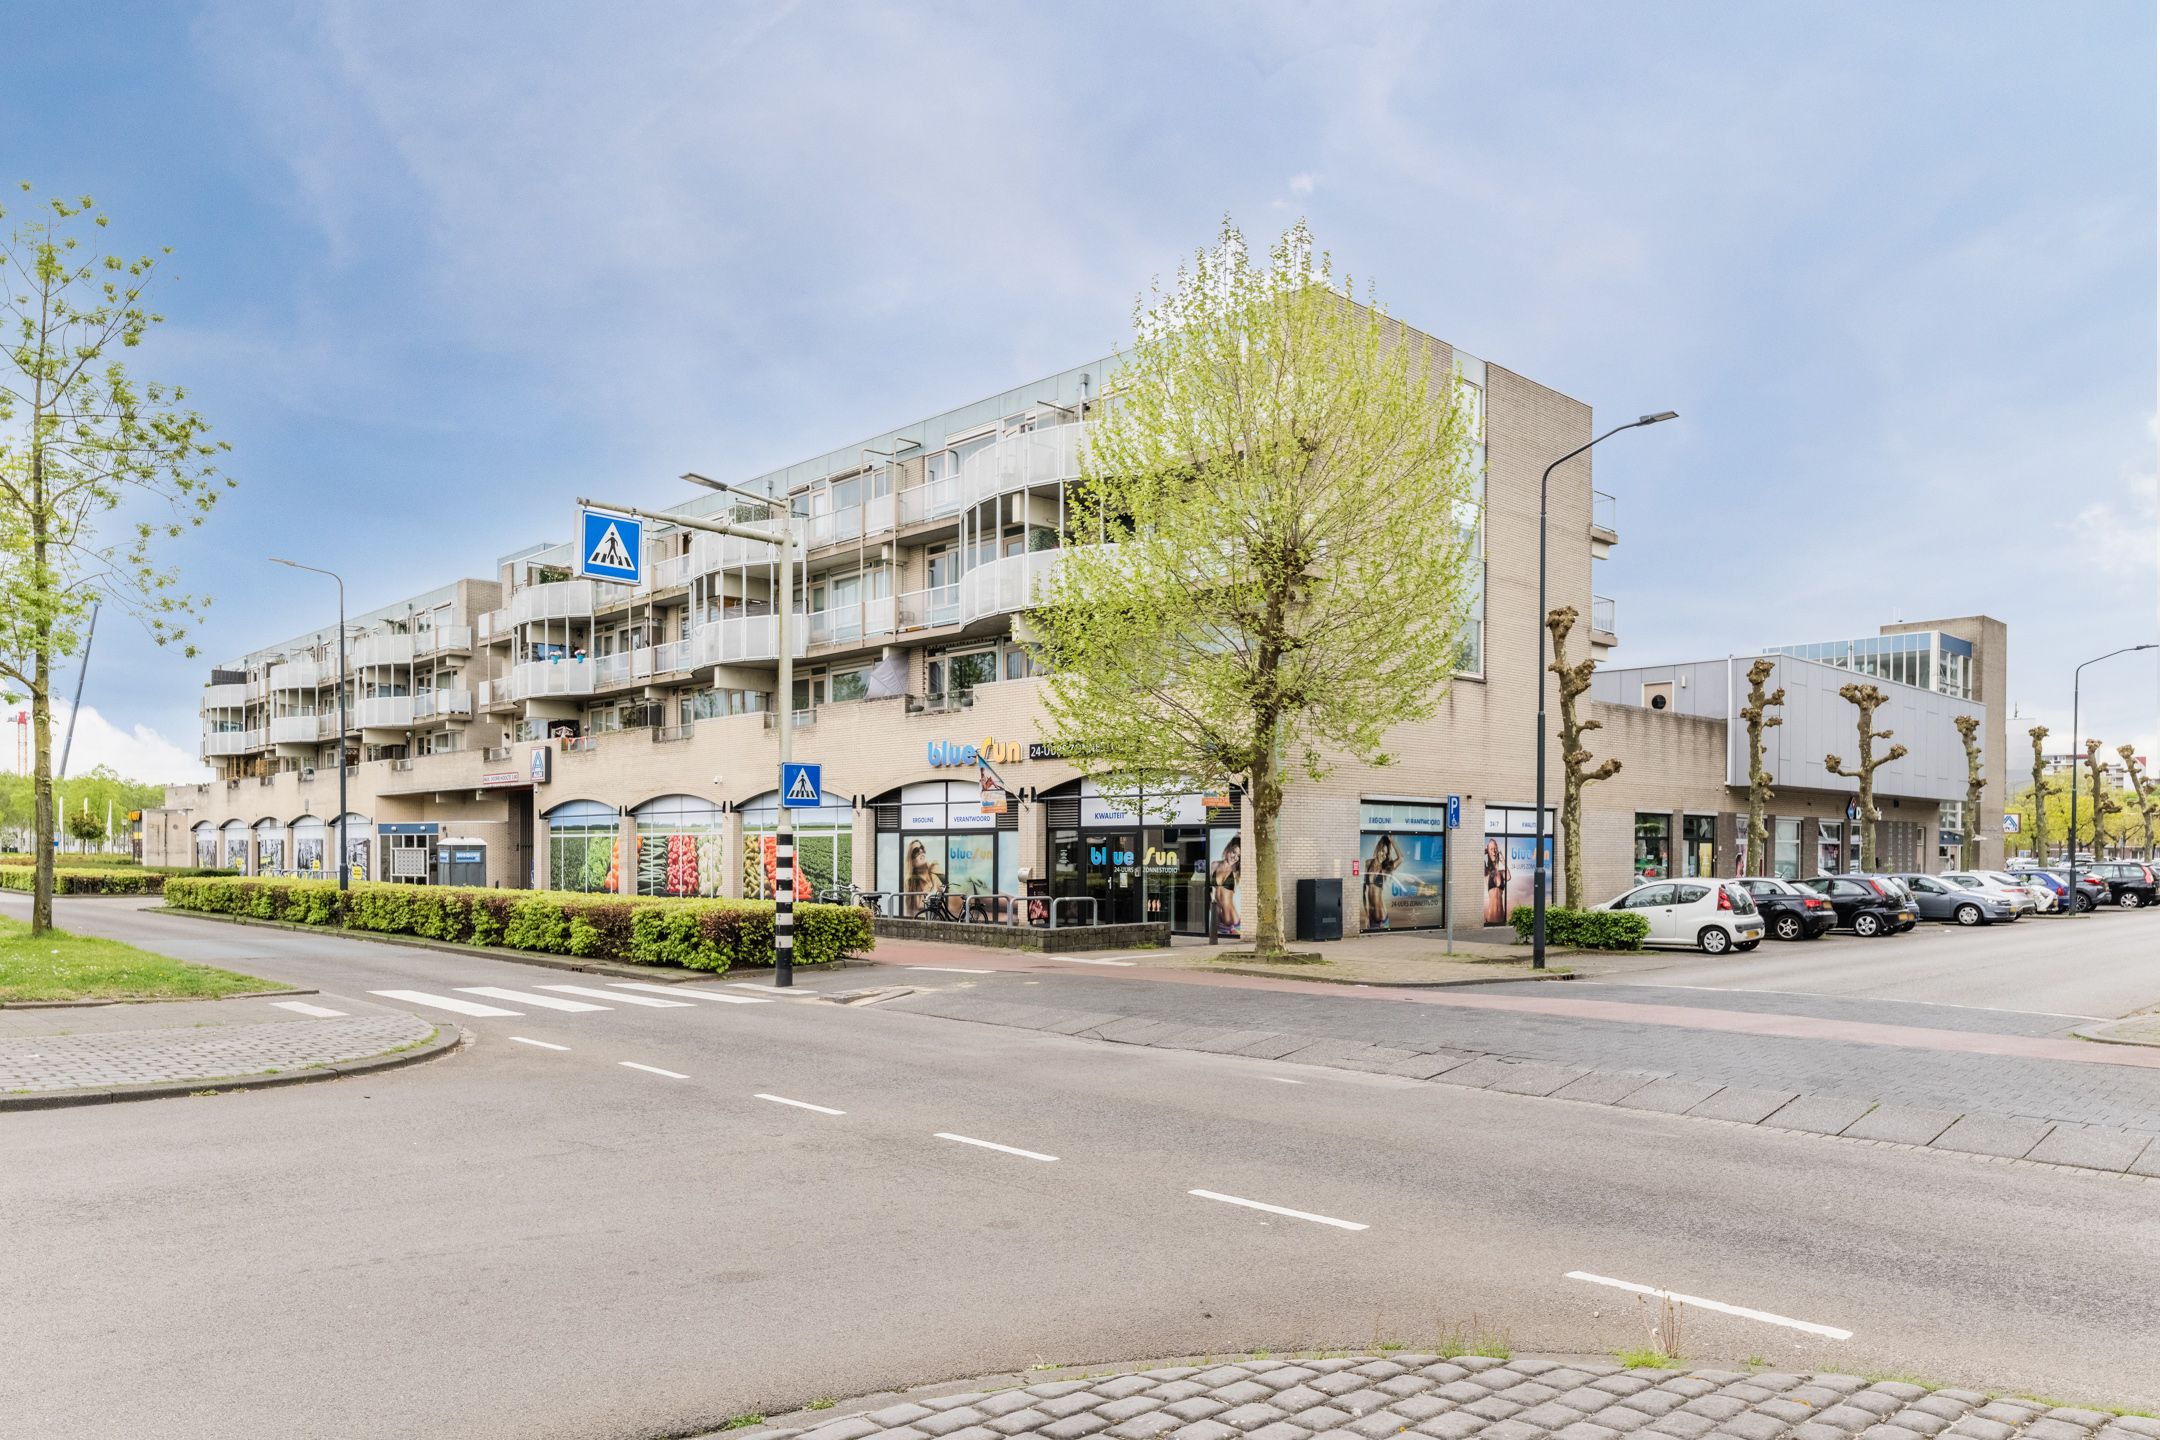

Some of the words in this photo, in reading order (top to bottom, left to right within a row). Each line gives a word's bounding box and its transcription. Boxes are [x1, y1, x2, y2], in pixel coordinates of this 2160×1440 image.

[928, 740, 976, 767] blue
[1451, 797, 1458, 814] P
[953, 815, 991, 823] VERANTWOORD
[1094, 812, 1125, 820] KWALITEIT
[950, 848, 972, 859] blue
[1091, 847, 1134, 865] blue
